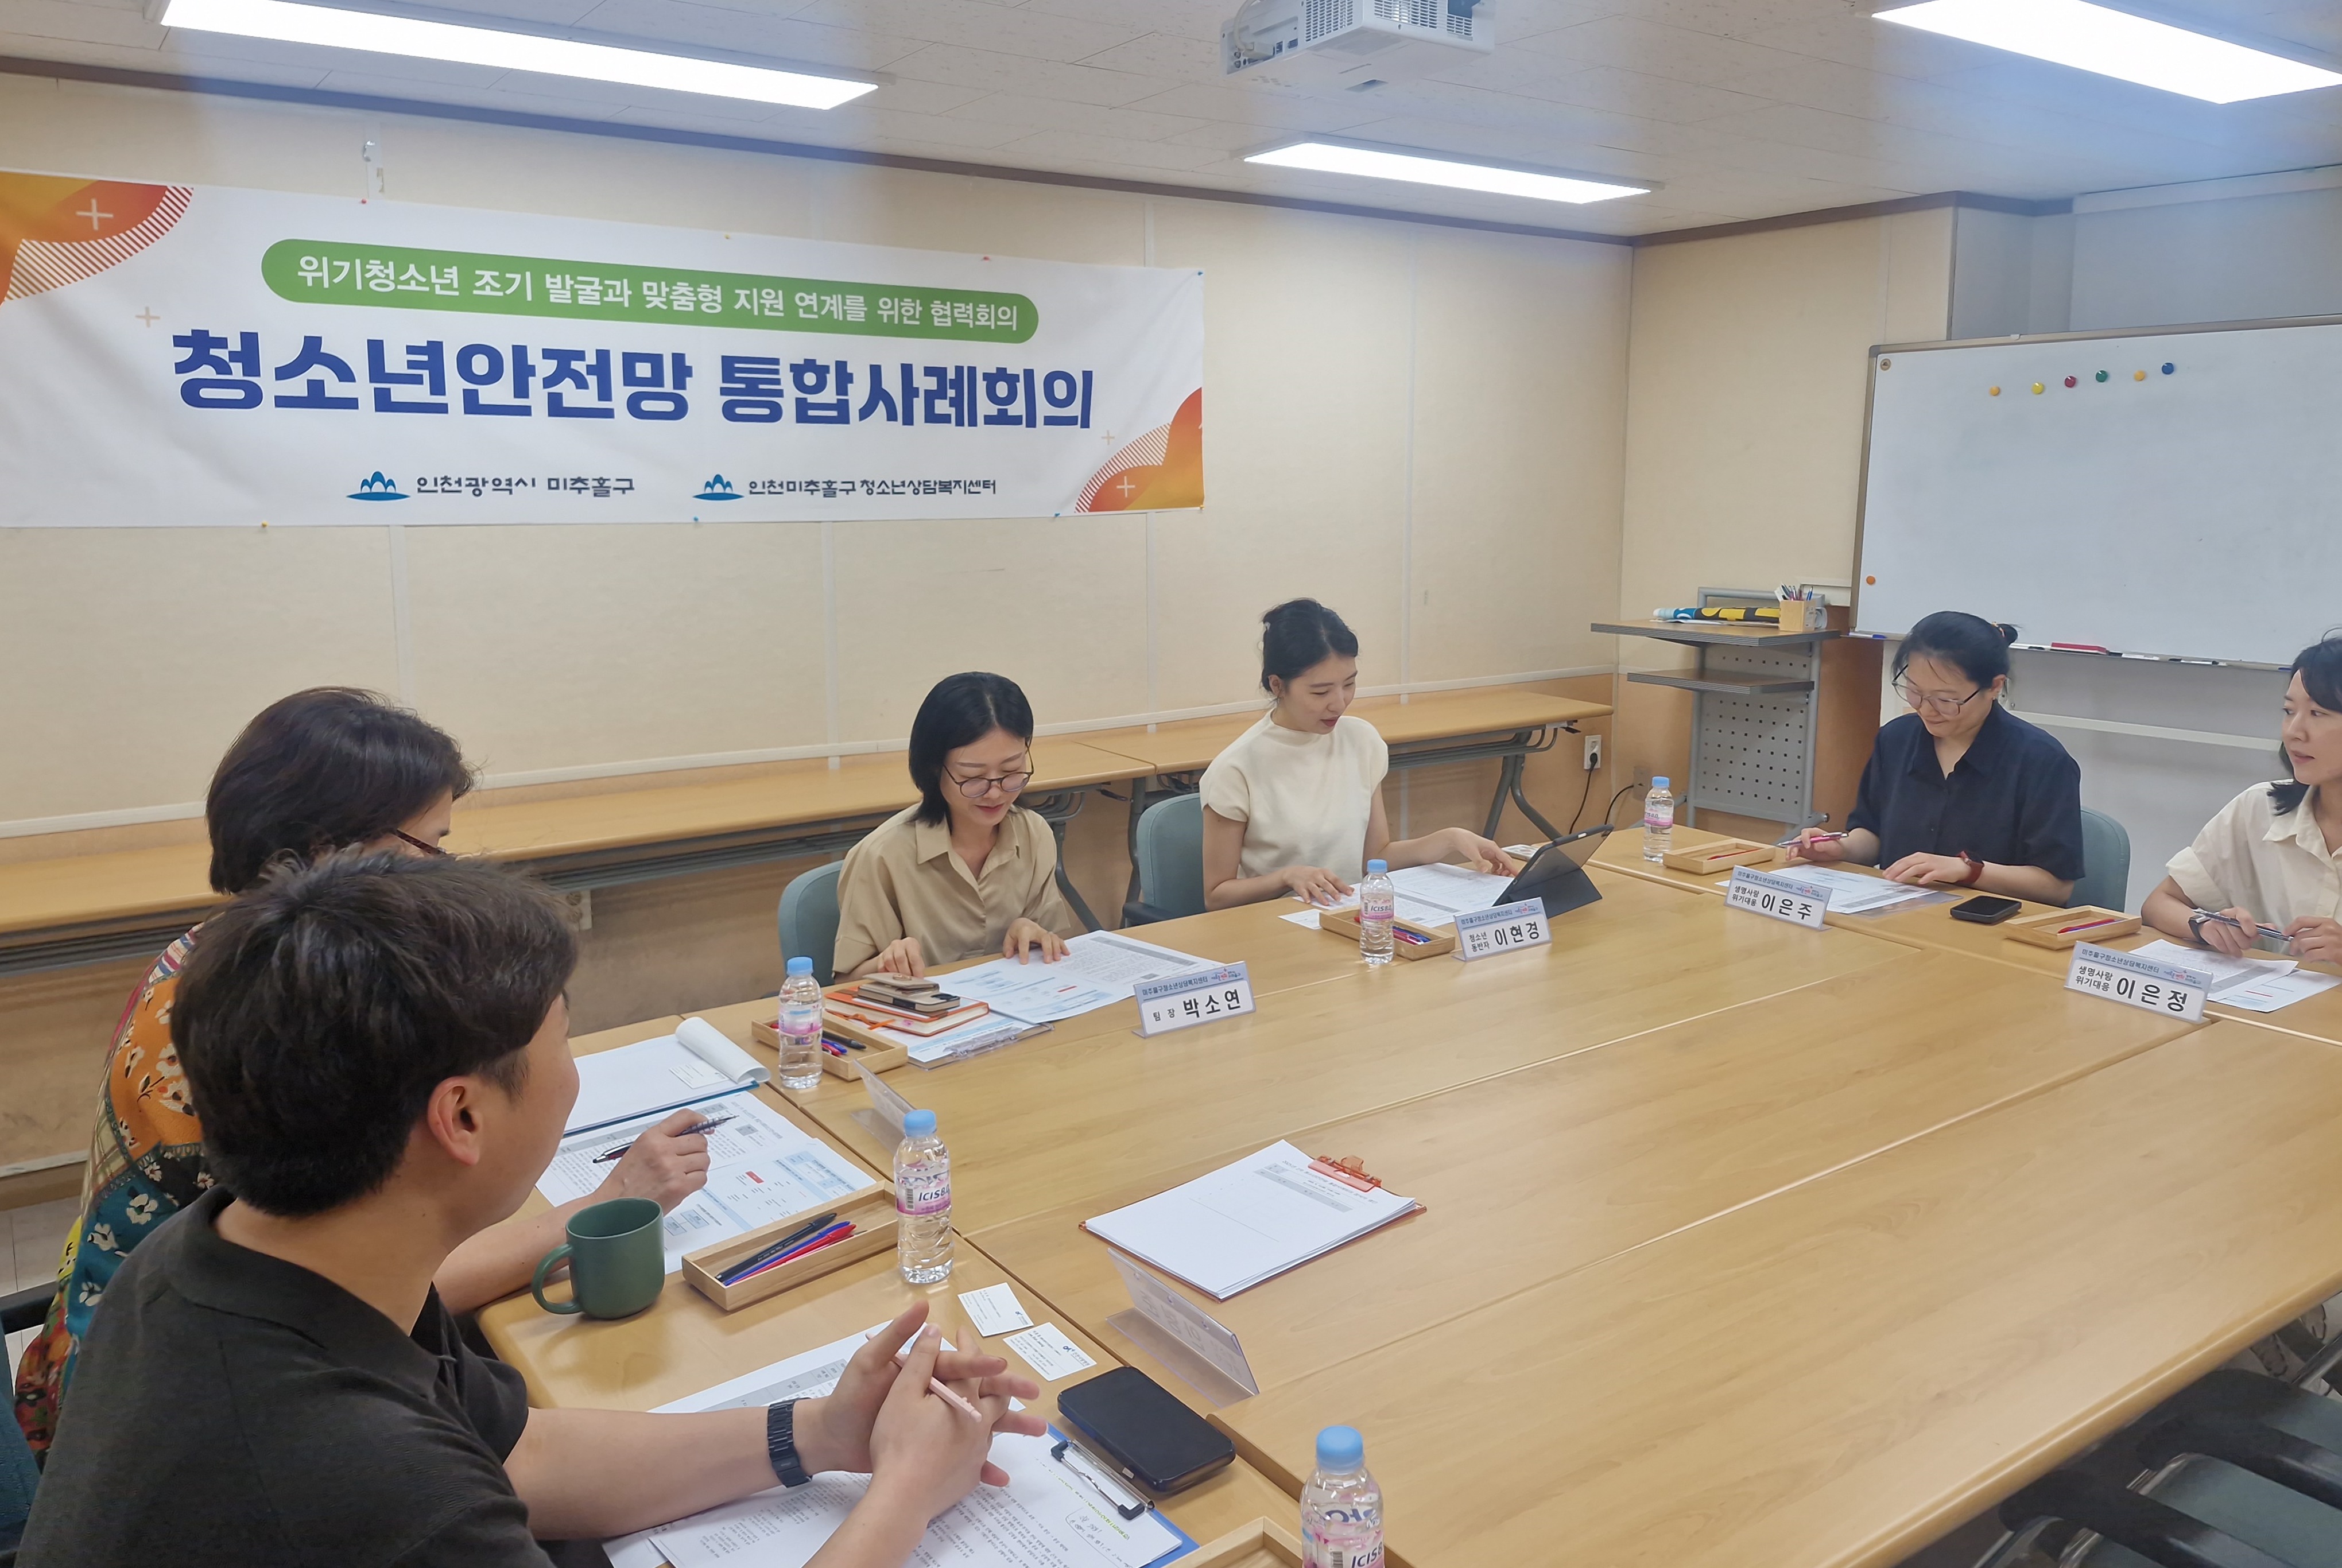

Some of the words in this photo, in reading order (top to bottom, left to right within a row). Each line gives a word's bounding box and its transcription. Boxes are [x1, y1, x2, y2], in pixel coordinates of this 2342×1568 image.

[297, 255, 460, 296] 위기청소년
[472, 269, 533, 301] 조기
[545, 274, 632, 308] 발굴과
[642, 281, 723, 314] 맞춤형
[734, 288, 784, 317] 지원
[794, 292, 867, 323] 연계를
[878, 297, 922, 325] 위한
[930, 300, 1018, 332] 협력회의
[172, 329, 693, 421] 청소년안전망
[719, 355, 1094, 429] 통합사례회의
[416, 475, 536, 498] 인천광역시
[547, 476, 635, 498] 미추홀구
[1732, 894, 1757, 906] 위기대응
[1735, 885, 1759, 898] 생명사랑
[1762, 894, 1812, 919] 이은주
[1469, 932, 1487, 942] 청소년
[1494, 921, 1540, 946] 이현경
[1471, 941, 1490, 952] 동반자
[2076, 976, 2110, 992] 위기대응
[2079, 965, 2113, 981] 생명사랑
[1183, 989, 1240, 1018] 박소연
[2116, 977, 2188, 1012] 이은정
